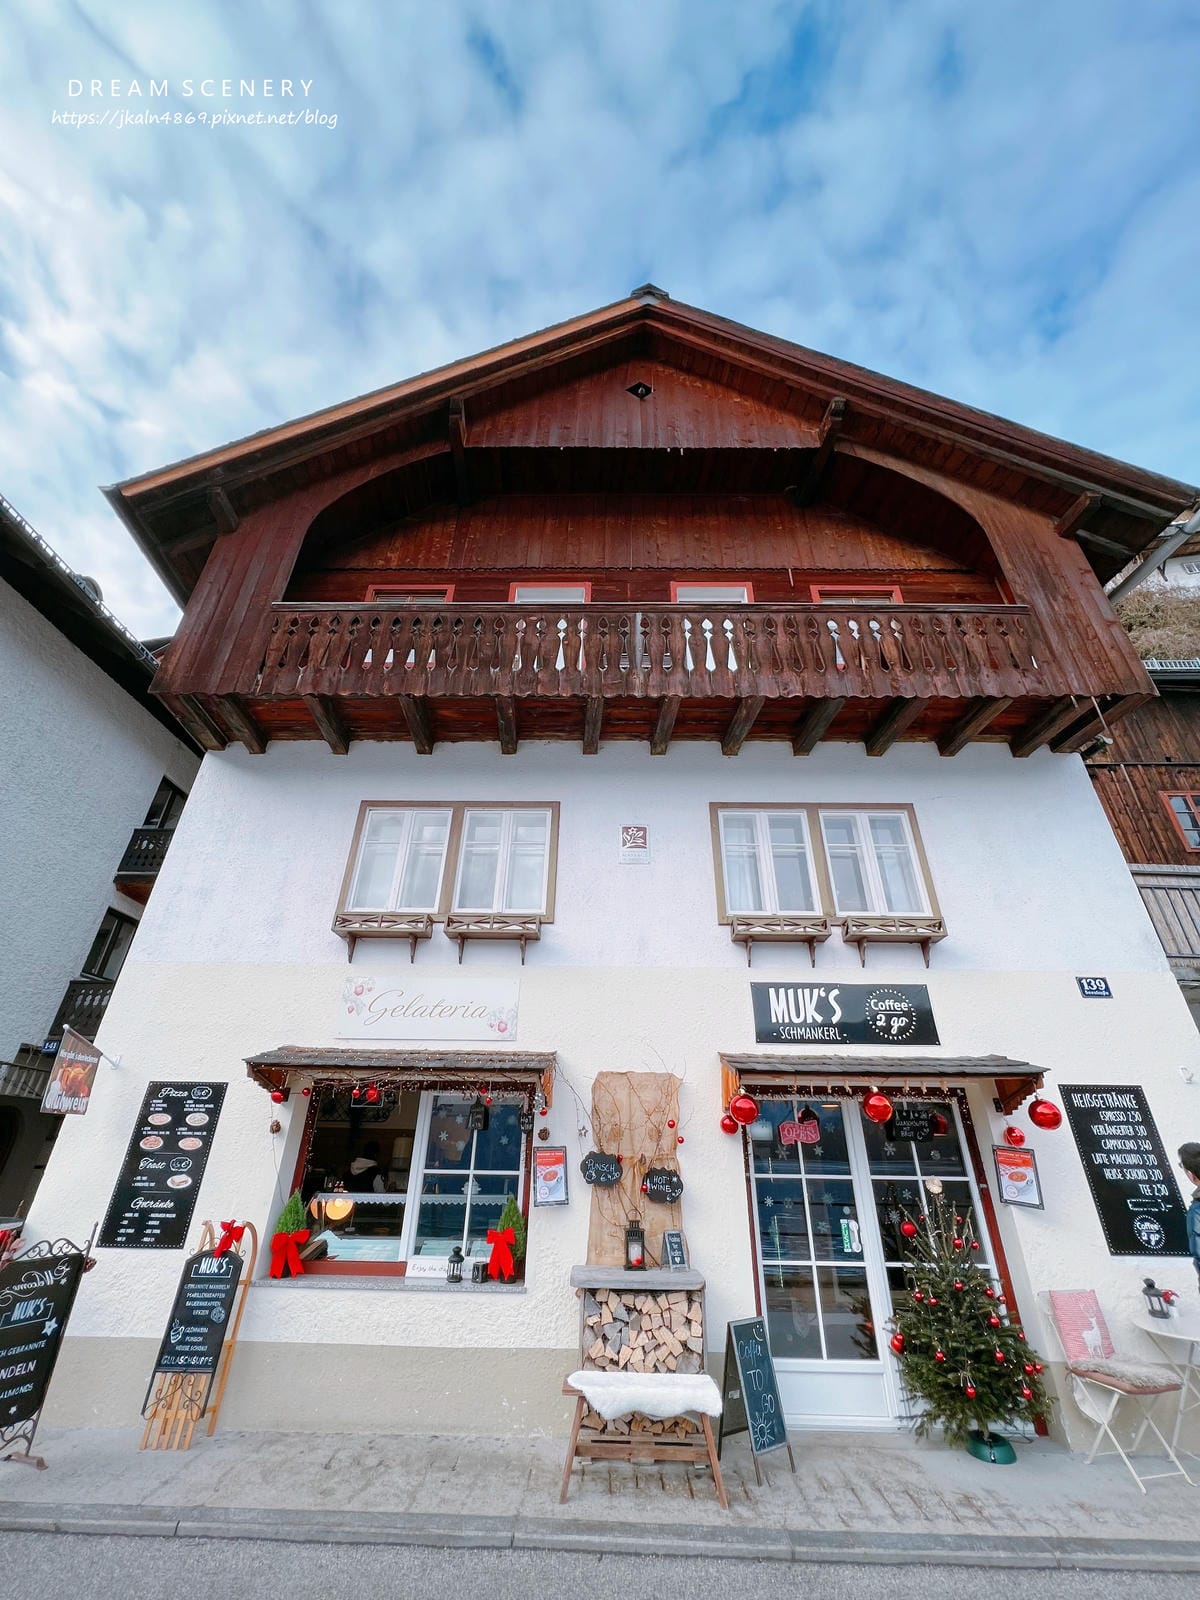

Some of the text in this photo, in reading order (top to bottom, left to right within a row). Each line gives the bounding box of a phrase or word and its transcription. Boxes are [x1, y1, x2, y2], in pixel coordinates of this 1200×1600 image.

[1080, 978, 1106, 990] 139
[364, 989, 490, 1026] Gelateria
[870, 999, 909, 1011] Coffee
[876, 1014, 909, 1034] 2 go
[780, 1026, 842, 1040] SCHMANKERL
[158, 1087, 188, 1098] Pizza
[1099, 1110, 1142, 1122] ESPRESSO 2,50
[784, 1126, 816, 1141] OPEN
[1091, 1124, 1135, 1136] VERLÄNGERTER
[1101, 1139, 1152, 1151] CAPPUCCINO 3,40
[138, 1157, 166, 1170] Toast
[587, 1159, 616, 1172] PUNSCH
[1092, 1153, 1158, 1165] LATTE MACCHIATO 3,70
[653, 1175, 667, 1184] HOT
[1123, 1168, 1148, 1180] SCHOKO
[1148, 1169, 1163, 1180] 3,70
[1139, 1184, 1153, 1196] TEE
[130, 1196, 174, 1209] Getränke
[1136, 1222, 1159, 1231] Coffee
[841, 1223, 850, 1249] PUSH
[198, 1257, 229, 1274] MUK'S
[10, 1297, 48, 1322] MUK'S
[7, 1339, 47, 1356] GEBRANNTE
[161, 1355, 214, 1366] GULASCHSUPPE
[746, 1368, 764, 1391] TO
[761, 1393, 775, 1414] GO
